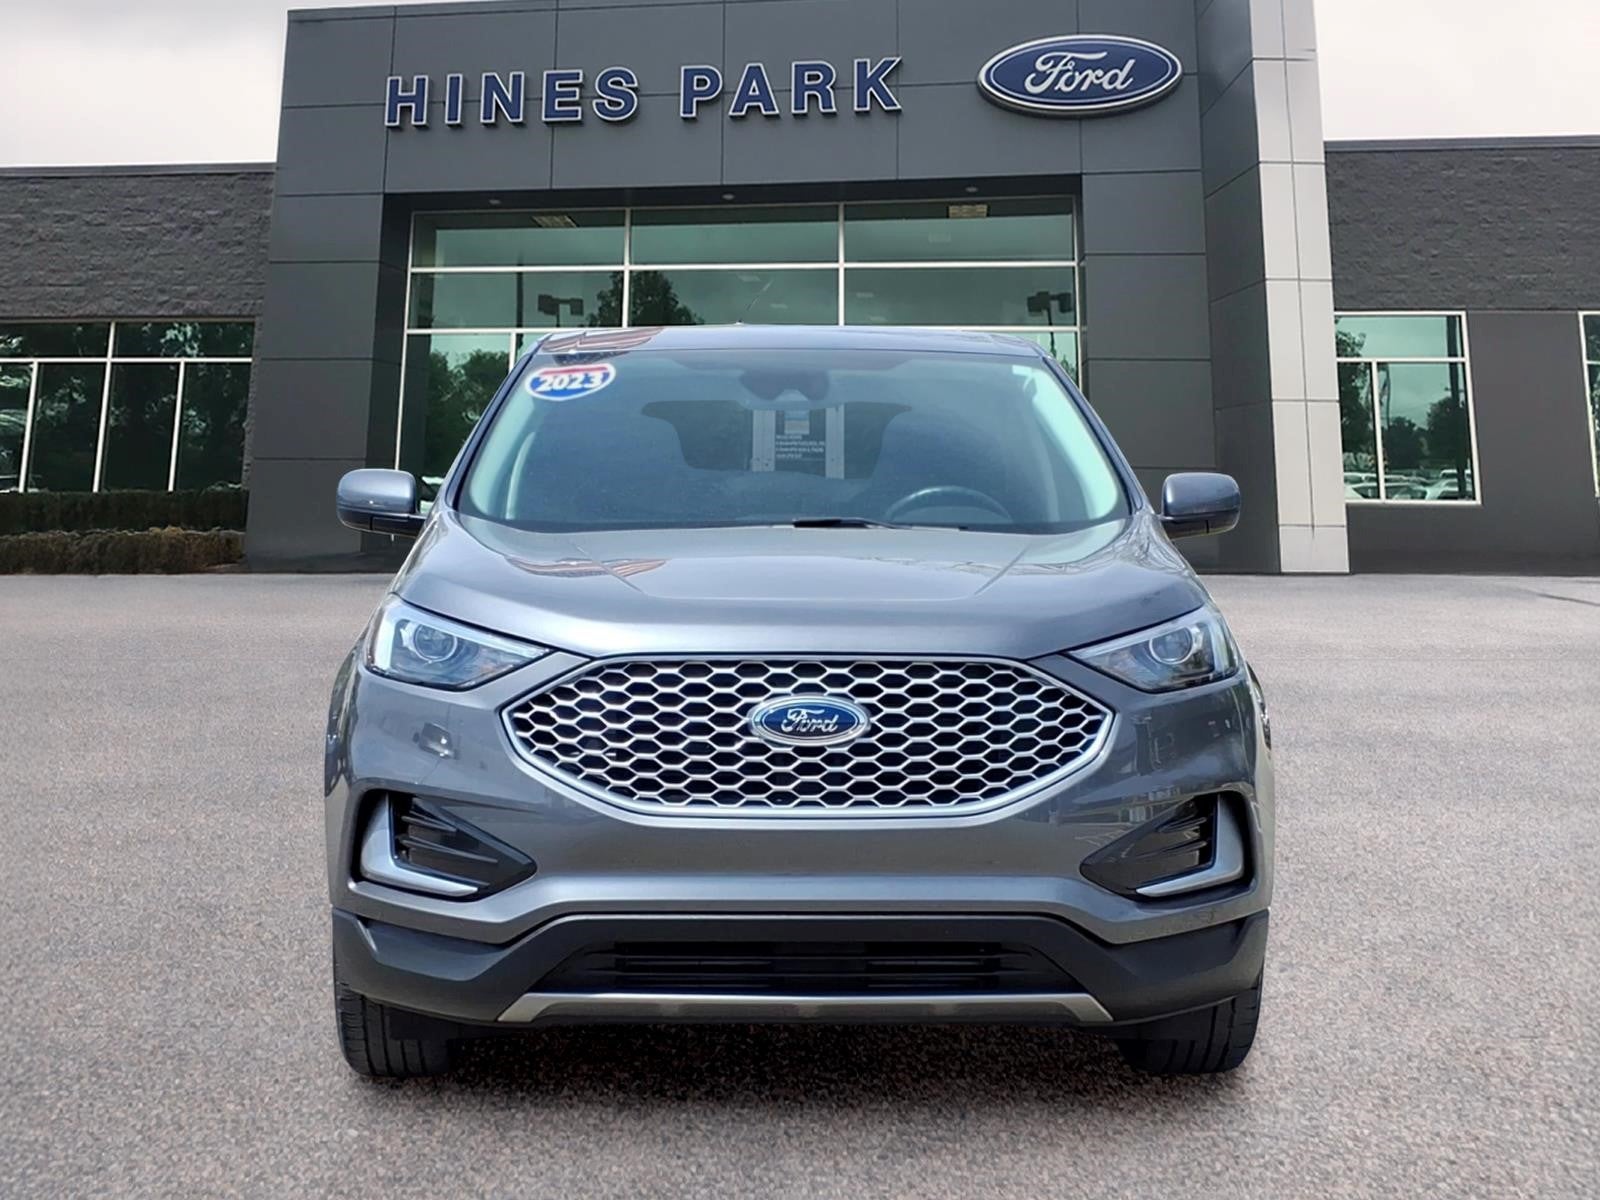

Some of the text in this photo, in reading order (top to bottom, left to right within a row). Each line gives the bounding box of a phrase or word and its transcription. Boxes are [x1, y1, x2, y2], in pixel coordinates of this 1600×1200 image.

[1024, 51, 1136, 94] Ford
[384, 56, 902, 127] HINES PARK
[535, 370, 603, 392] 2023
[780, 708, 840, 732] Ford
